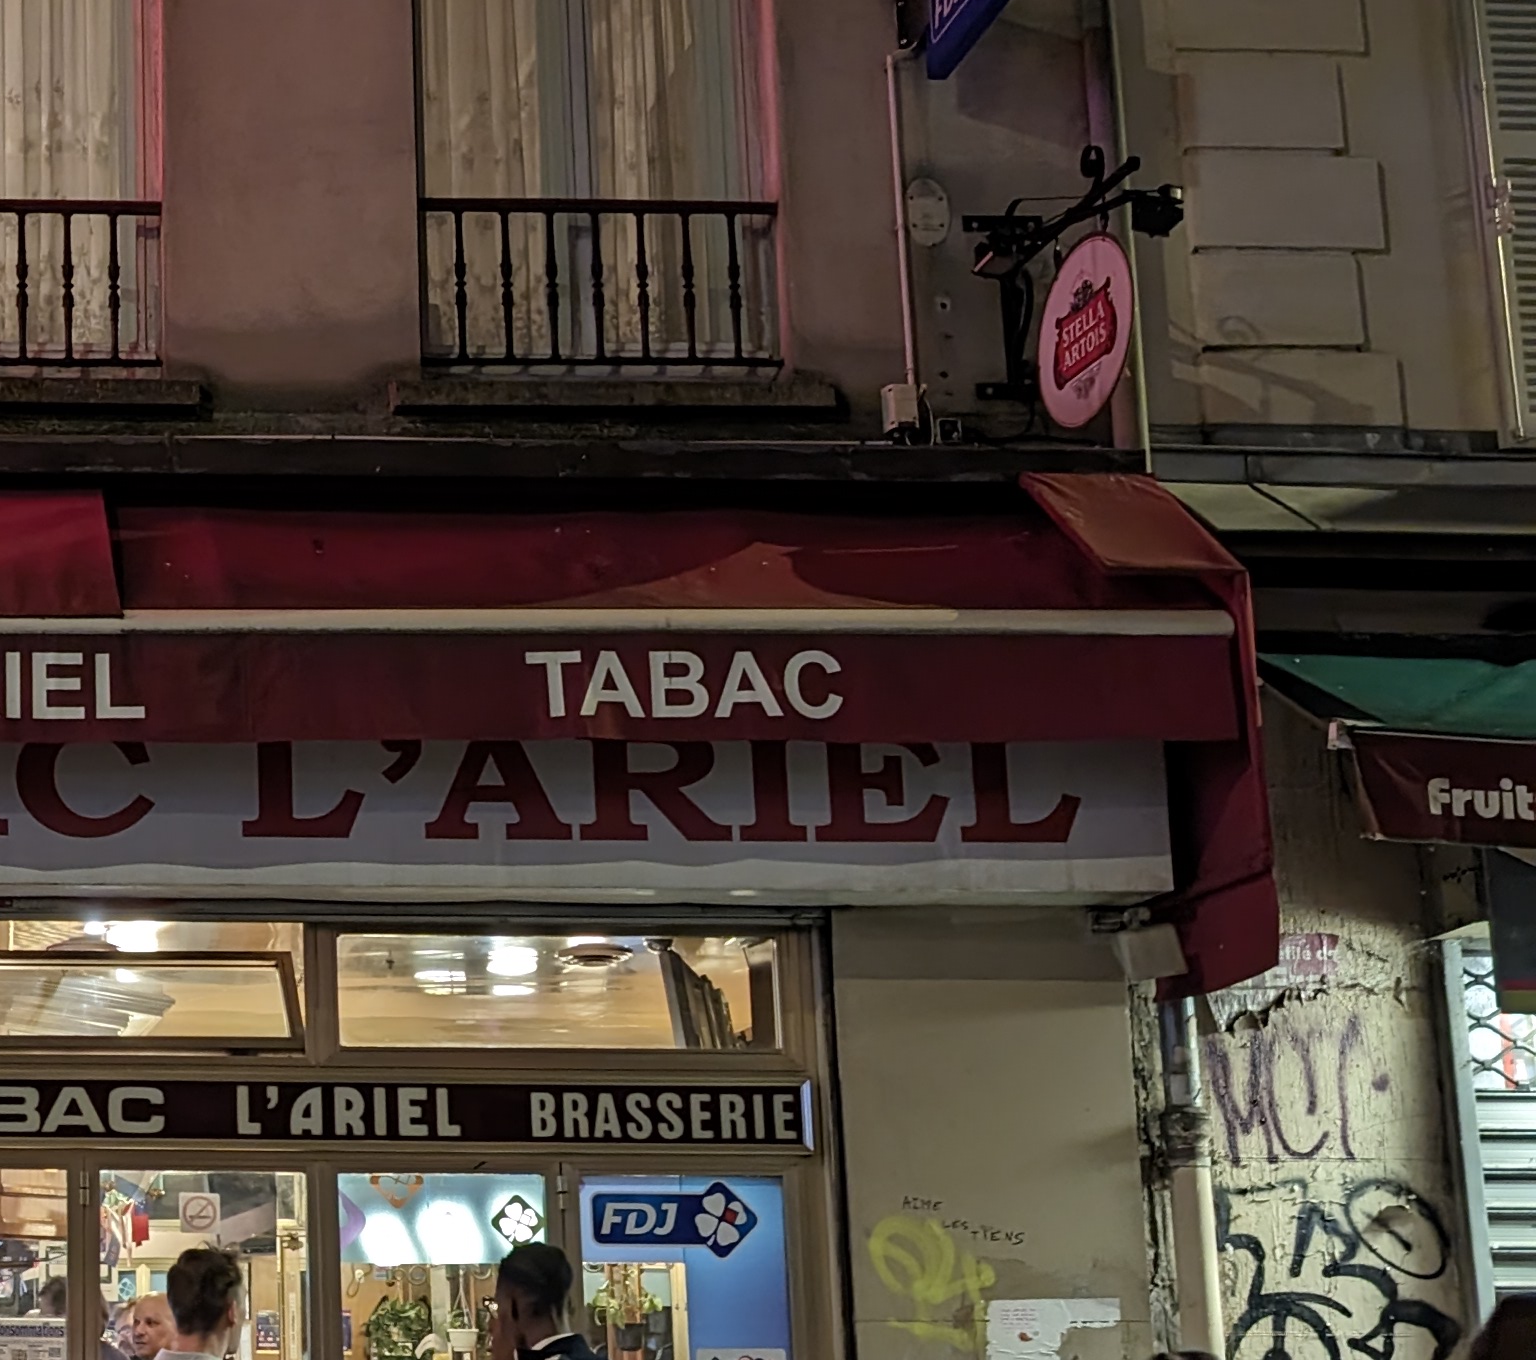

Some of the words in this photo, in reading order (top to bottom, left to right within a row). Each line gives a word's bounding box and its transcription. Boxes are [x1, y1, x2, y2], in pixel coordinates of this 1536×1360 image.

[1062, 300, 1105, 348] STELLA
[1063, 321, 1107, 371] ARTOIS
[525, 649, 844, 719] TABAC
[530, 1091, 798, 1141] BRASSERIE
[600, 1200, 679, 1237] FDJ
